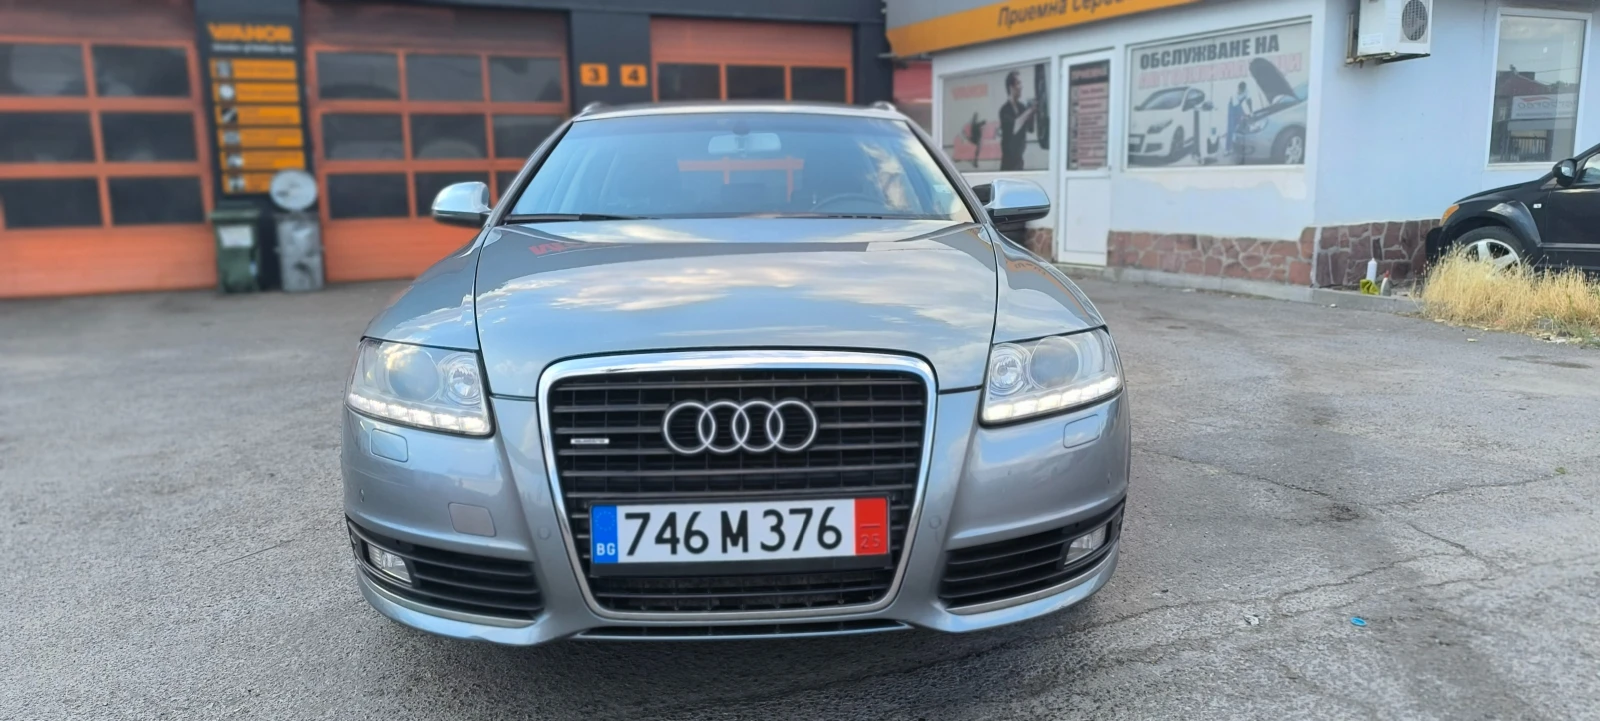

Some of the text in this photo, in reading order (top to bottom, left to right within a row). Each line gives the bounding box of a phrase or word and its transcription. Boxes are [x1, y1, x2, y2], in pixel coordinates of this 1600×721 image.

[1140, 34, 1279, 70] ОБСЛУЖВАНЕ НА
[588, 67, 601, 83] 3
[628, 69, 640, 84] 4
[625, 506, 842, 556] 746 M 376
[860, 533, 881, 549] 25
[596, 543, 616, 556] BG
